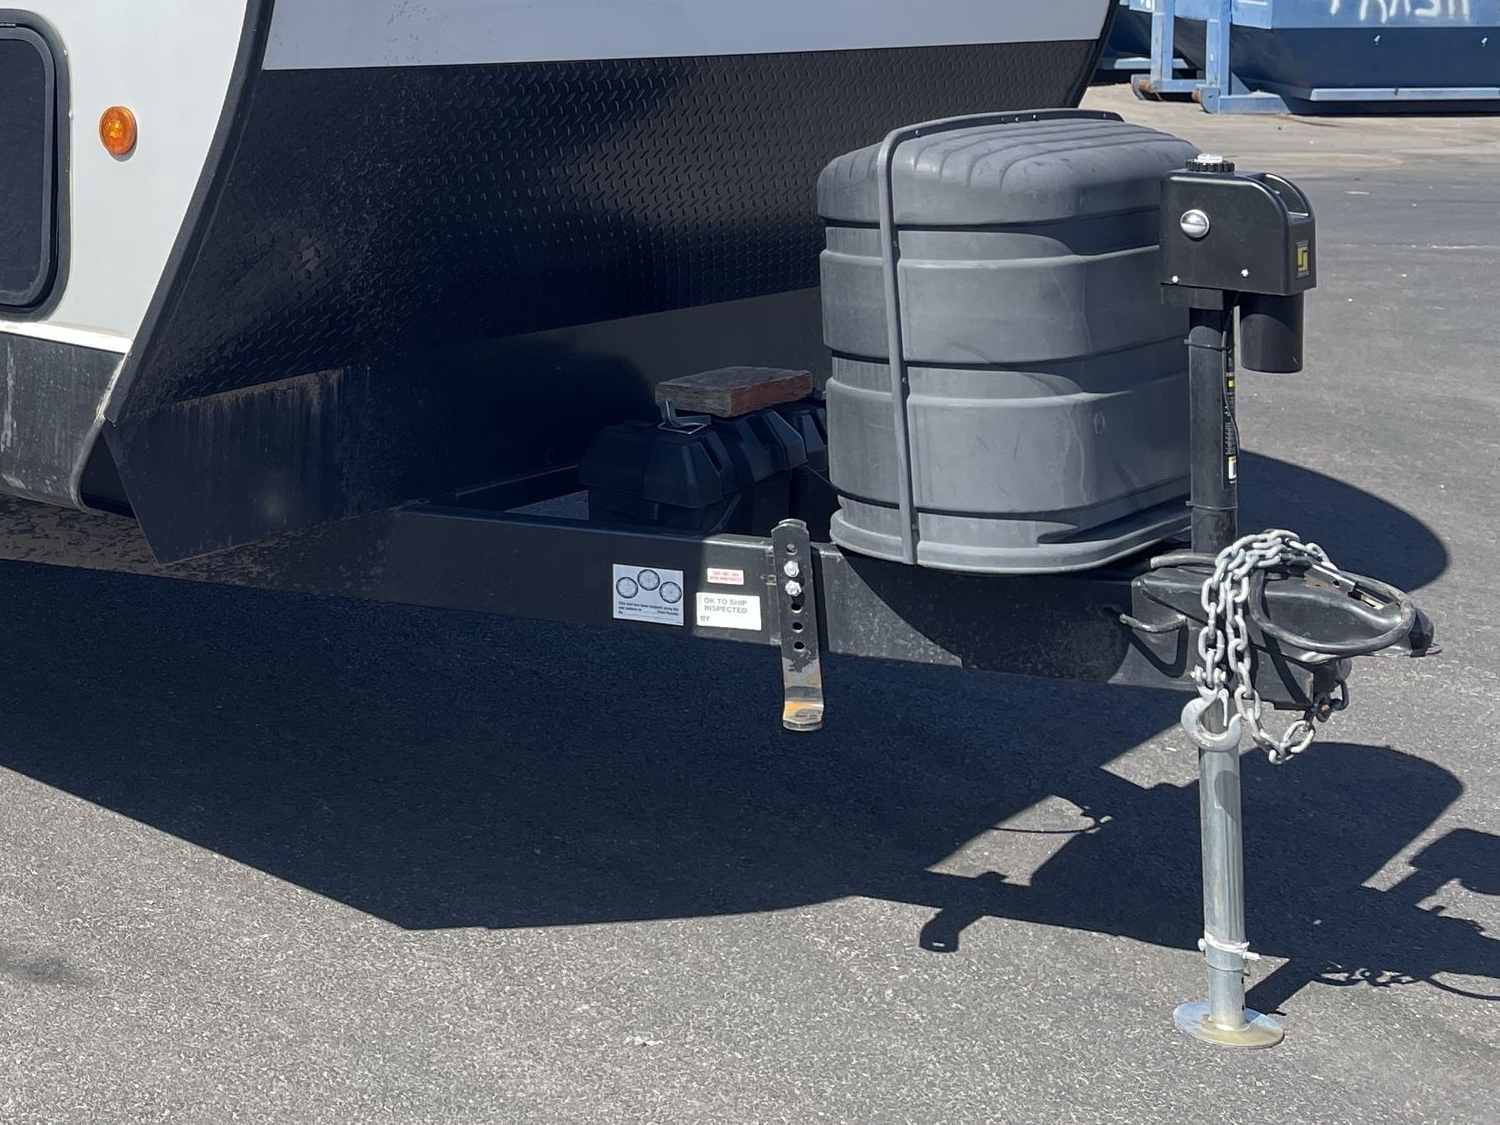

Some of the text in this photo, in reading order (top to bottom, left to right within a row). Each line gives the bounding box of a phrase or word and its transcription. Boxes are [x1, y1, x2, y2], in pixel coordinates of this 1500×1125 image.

[703, 597, 748, 607] OK TO SHIP
[704, 605, 748, 614] INSPECTED
